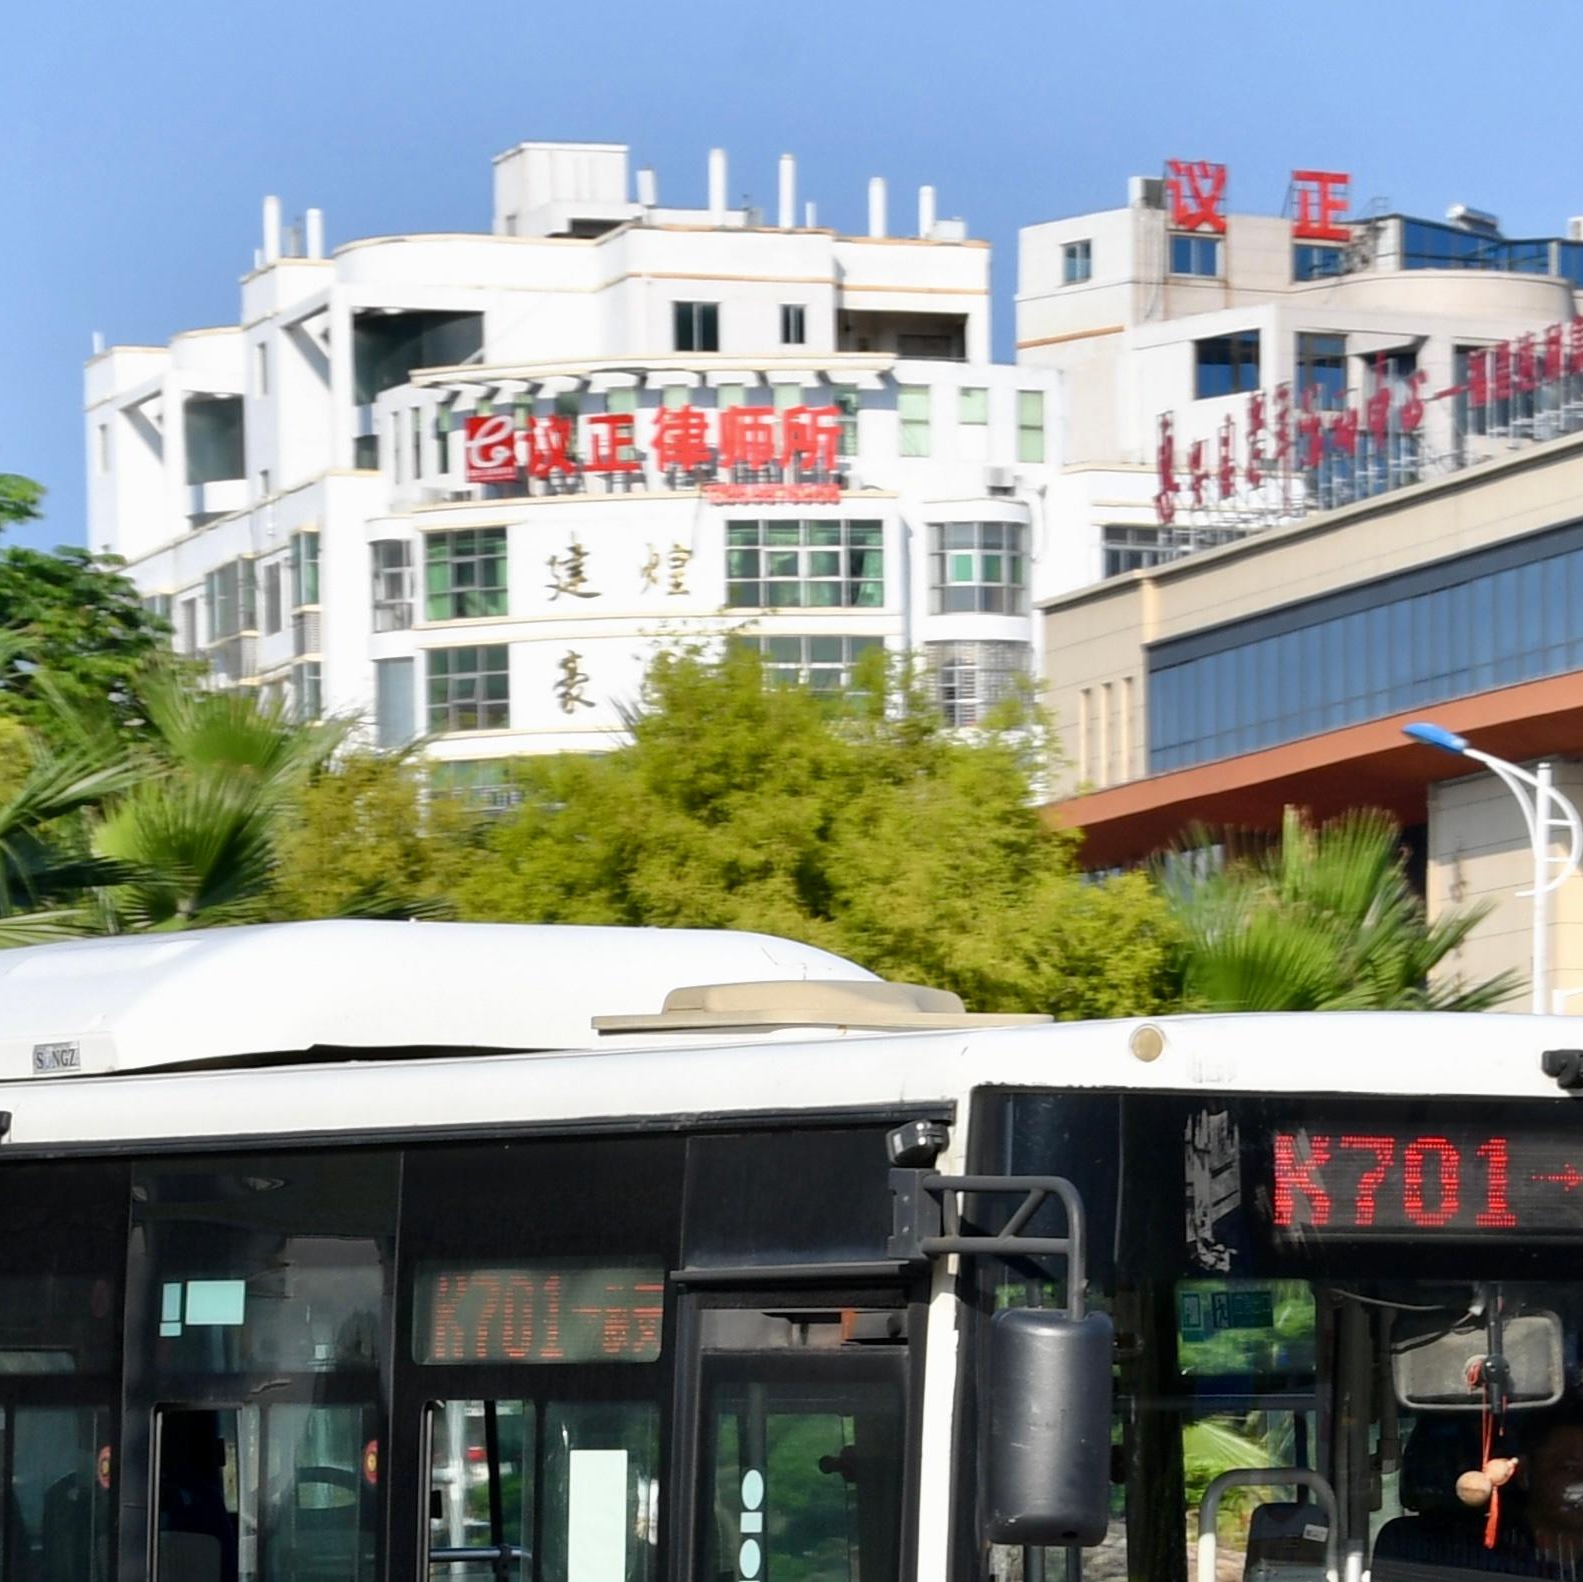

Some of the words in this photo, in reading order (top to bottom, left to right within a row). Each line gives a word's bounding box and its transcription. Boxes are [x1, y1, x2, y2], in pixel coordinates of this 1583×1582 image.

[1166, 158, 1352, 242] 议正
[519, 405, 844, 477] 议正律师所
[1273, 1135, 1517, 1228] K701
[434, 1274, 564, 1358] K701
